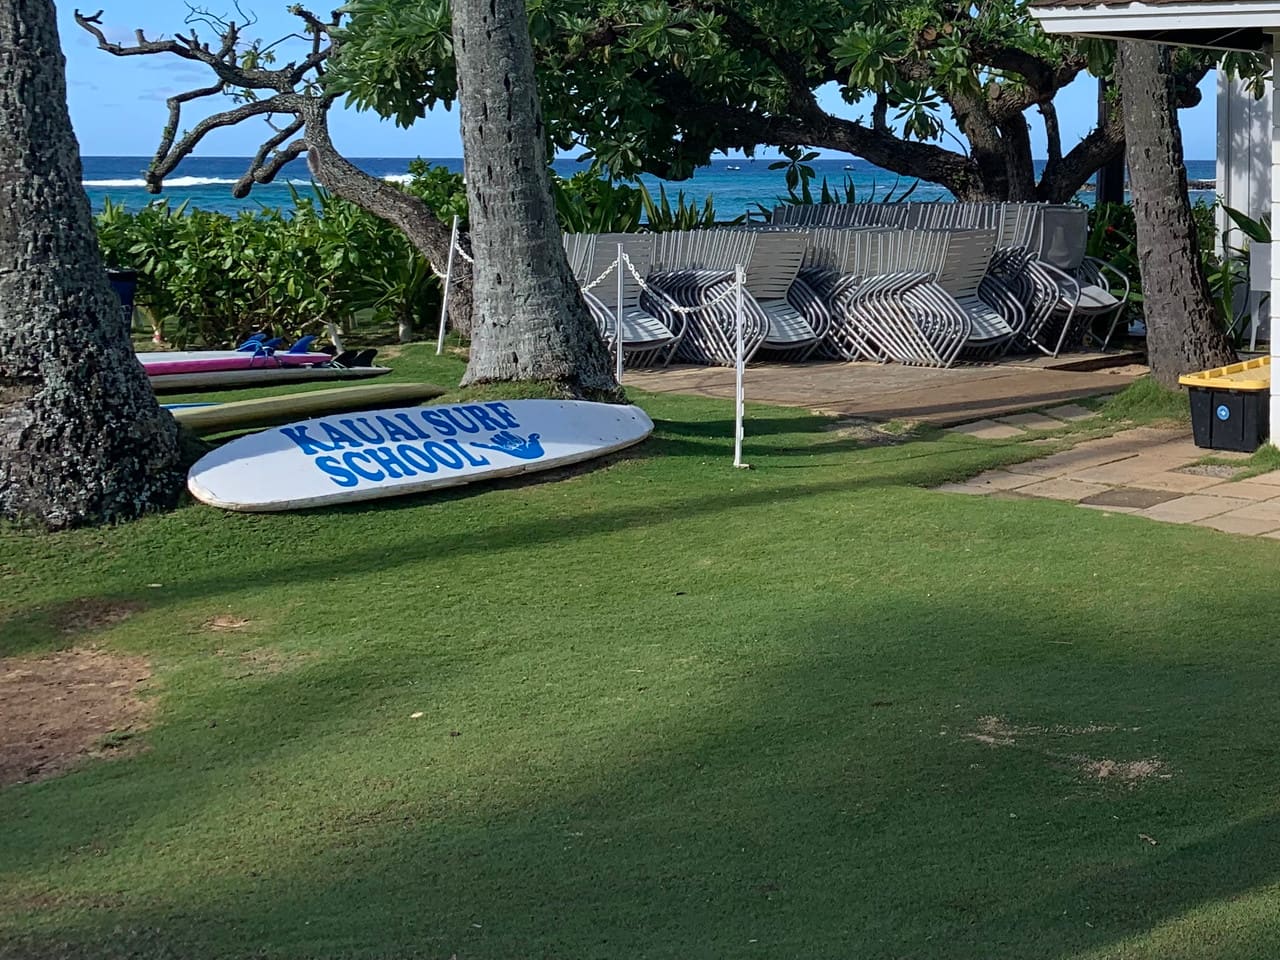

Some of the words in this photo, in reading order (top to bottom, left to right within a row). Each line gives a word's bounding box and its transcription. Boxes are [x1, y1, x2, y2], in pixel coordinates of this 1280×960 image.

[280, 413, 423, 455] KAUAI
[420, 402, 520, 436] SURF
[315, 438, 490, 487] SCHOOL
